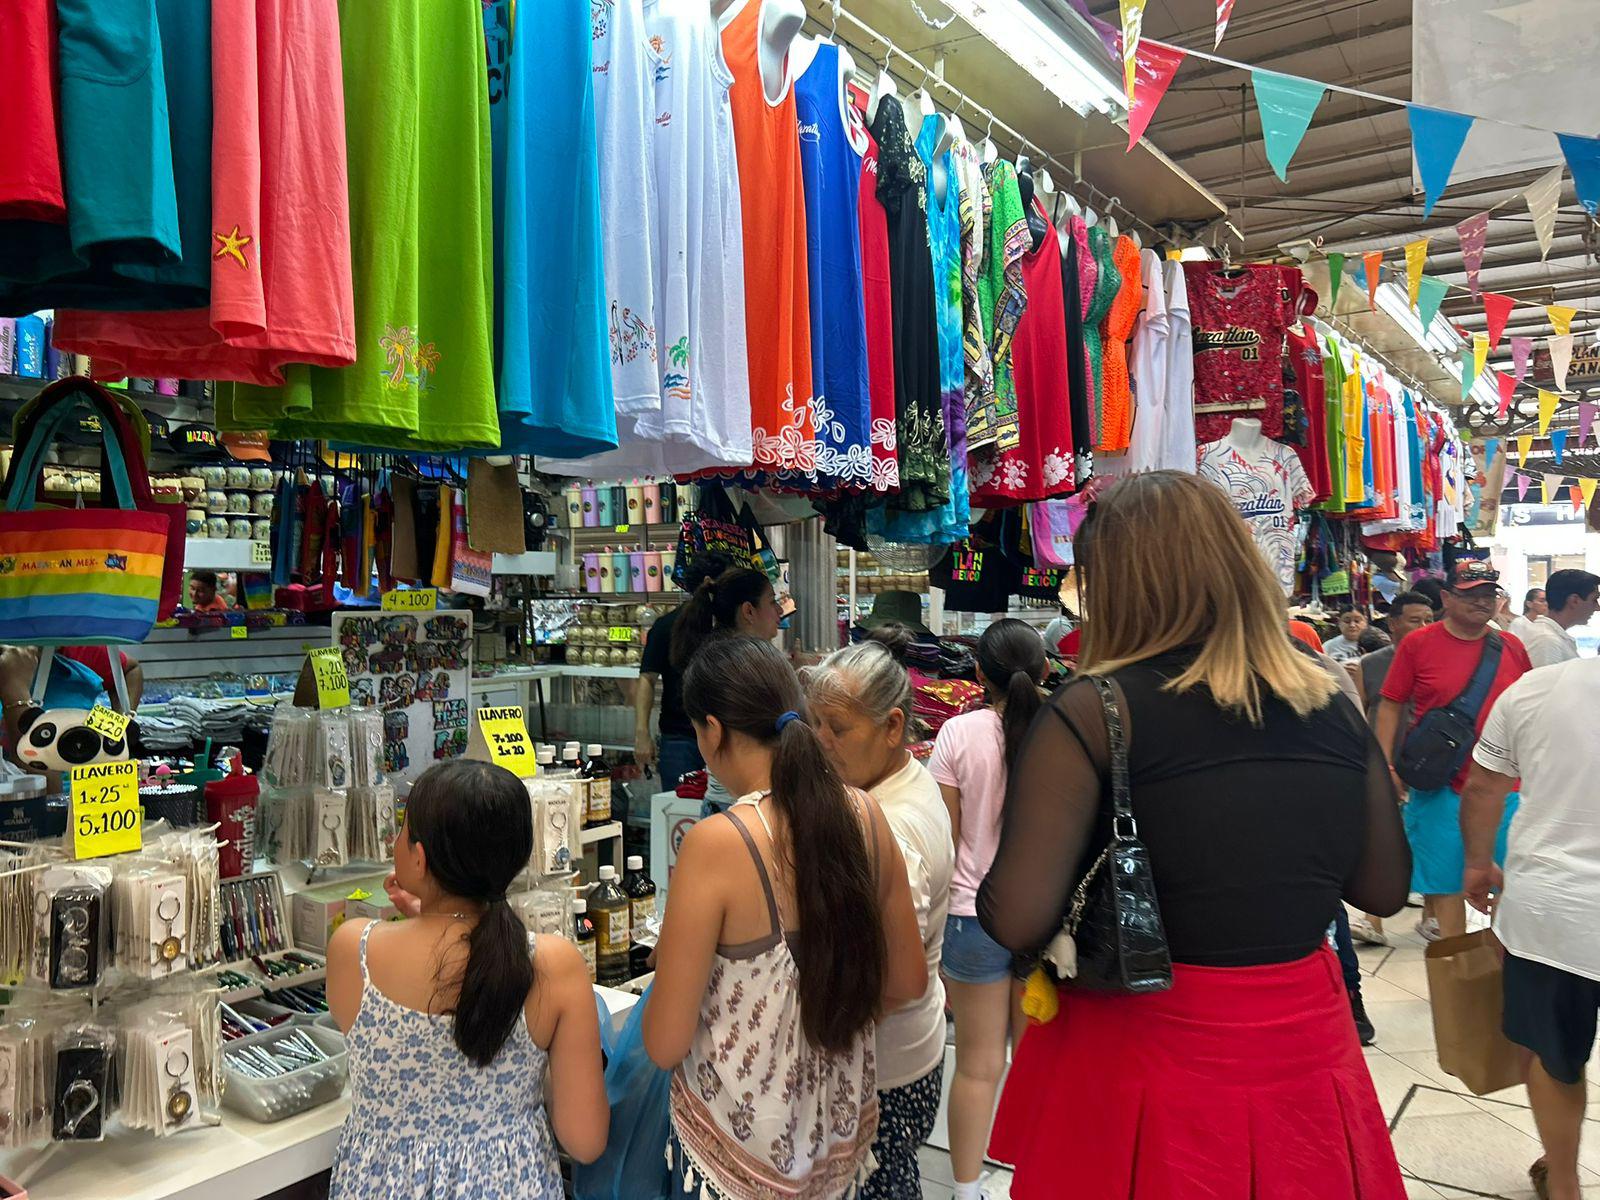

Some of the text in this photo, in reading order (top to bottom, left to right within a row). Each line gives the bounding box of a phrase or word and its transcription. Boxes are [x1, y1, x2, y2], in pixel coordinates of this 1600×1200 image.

[1242, 347, 1258, 360] 01
[1568, 361, 1600, 376] SAN
[1273, 516, 1285, 527] 01
[952, 551, 983, 571] TLAN
[1022, 574, 1057, 587] MEXICO
[480, 708, 522, 720] LLAVERO
[73, 764, 134, 781] LLAVERO
